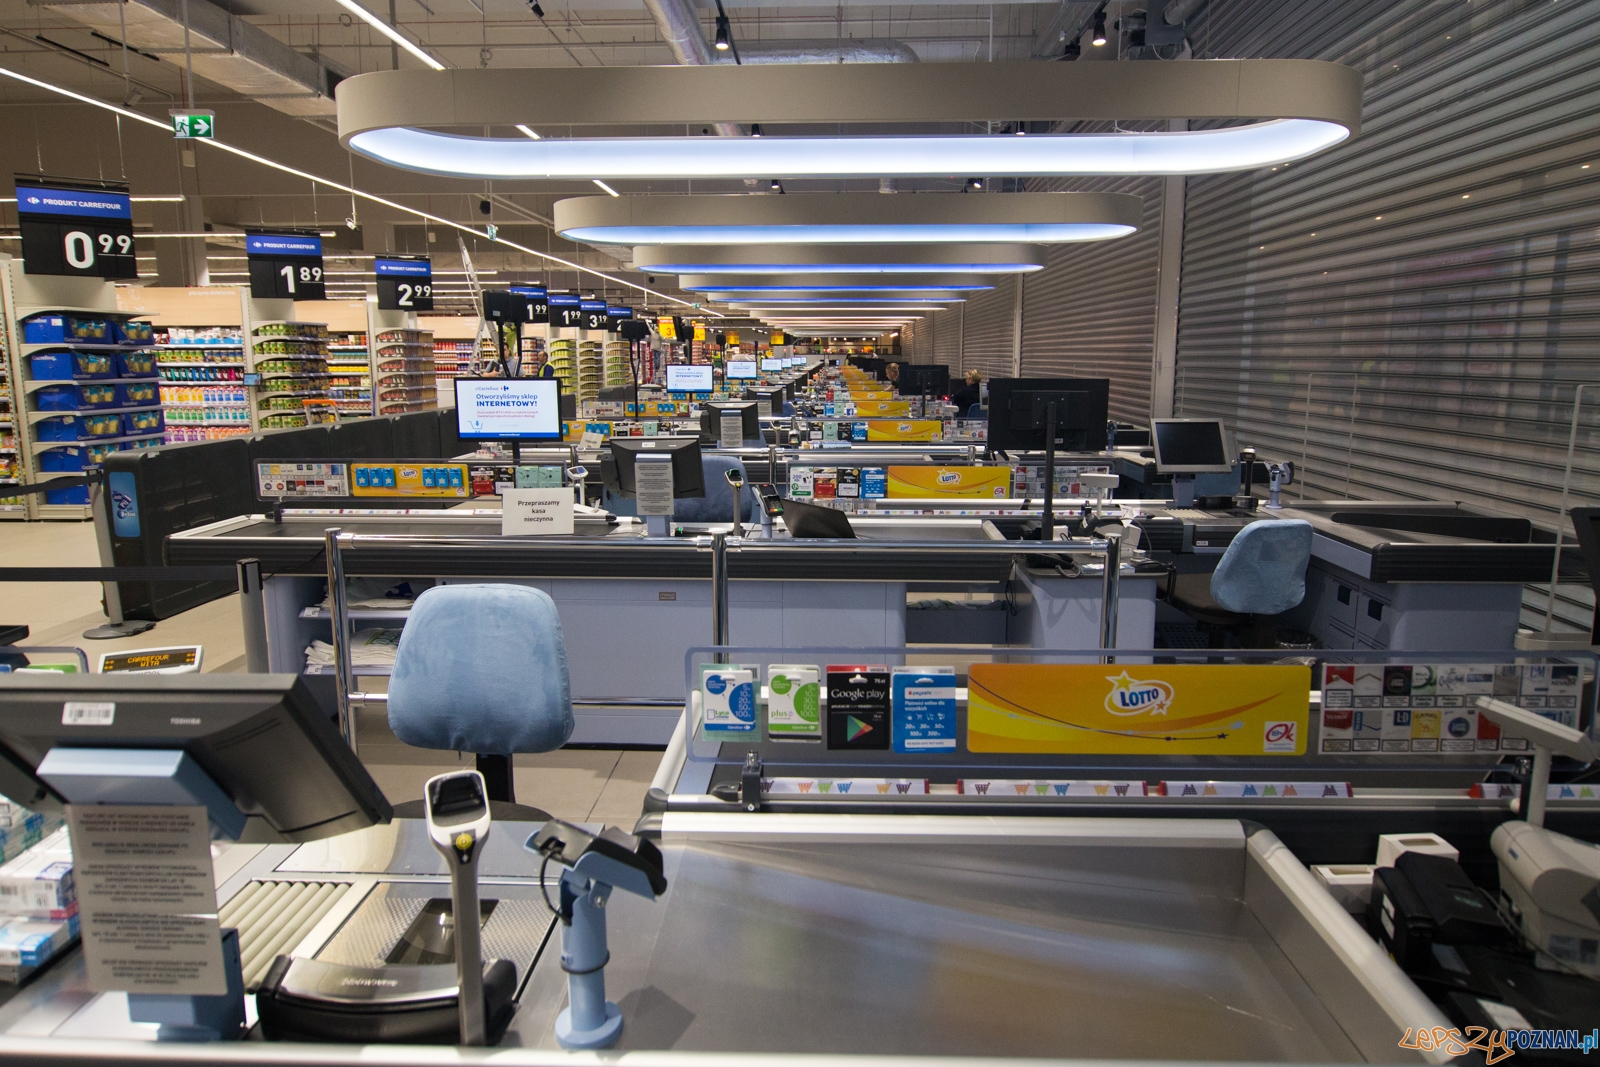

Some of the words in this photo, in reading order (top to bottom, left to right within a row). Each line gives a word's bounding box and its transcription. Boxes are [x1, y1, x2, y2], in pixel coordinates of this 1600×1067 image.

[42, 198, 78, 207] PRODUKT
[78, 201, 122, 210] CARREFOUR
[64, 230, 94, 268] 0
[98, 234, 132, 254] 99
[280, 266, 296, 293] 1
[300, 266, 322, 282] 89
[398, 284, 413, 306] 2
[414, 285, 432, 298] 99
[526, 304, 534, 320] 1
[535, 304, 547, 314] 99
[562, 310, 569, 324] 1
[570, 311, 581, 319] 99
[590, 314, 598, 328] 3
[127, 654, 170, 664] CARREFOUR
[831, 689, 864, 701] Google
[866, 689, 886, 700] play
[1120, 688, 1159, 707] LOTTO
[771, 709, 787, 717] plus
